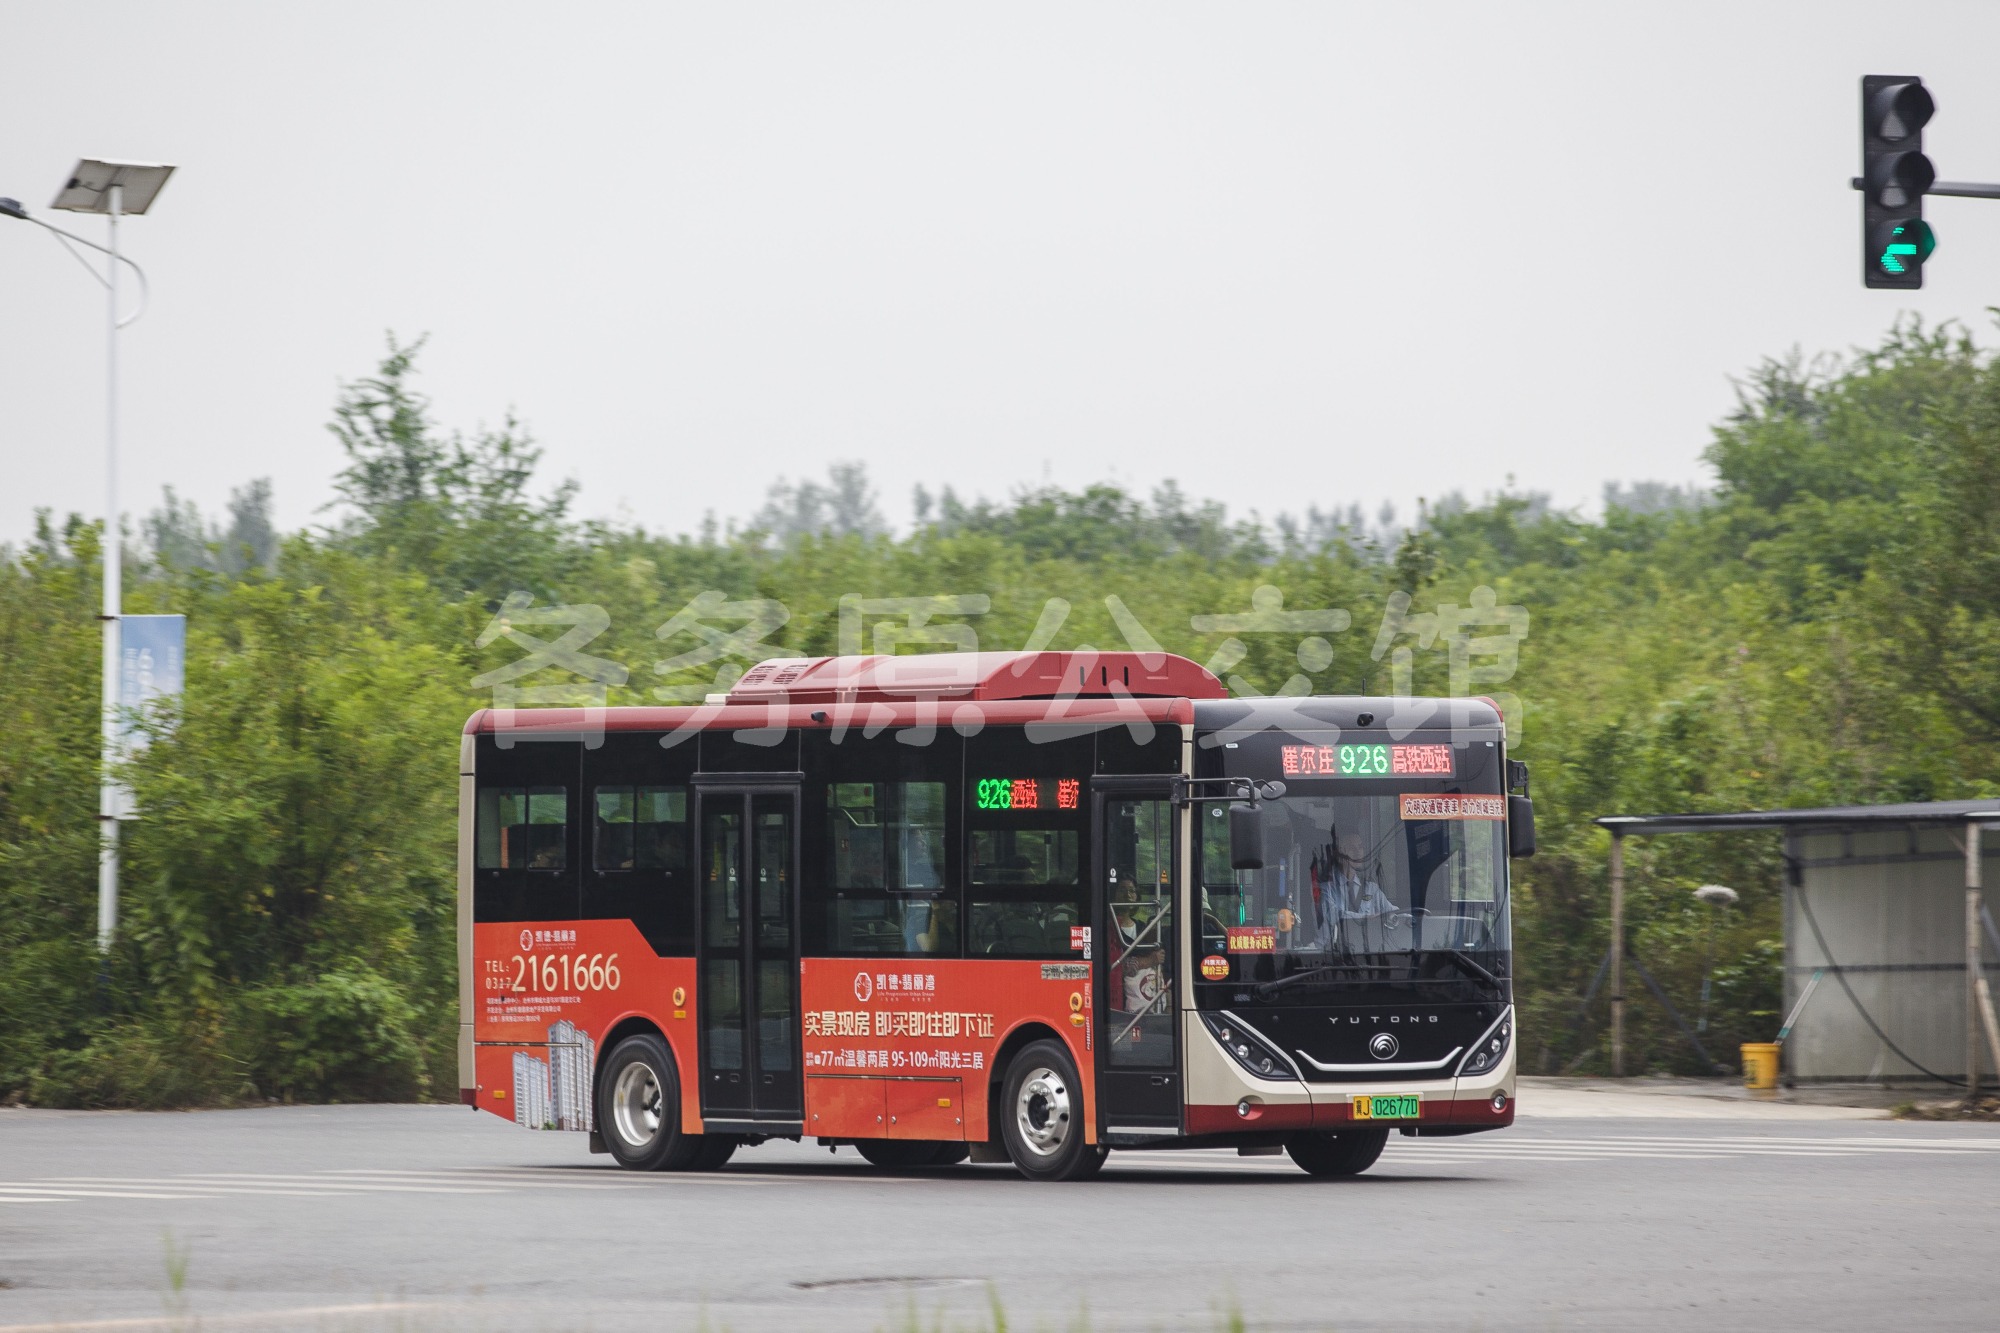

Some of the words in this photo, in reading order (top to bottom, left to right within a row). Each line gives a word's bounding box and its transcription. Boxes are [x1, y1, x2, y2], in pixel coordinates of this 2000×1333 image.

[1283, 746, 1335, 774] 崔尔庄
[1340, 745, 1388, 774] 926
[1391, 745, 1451, 774] 高铁西站
[978, 778, 1010, 808] 926
[1230, 935, 1274, 949] 优质服务示范车
[485, 960, 510, 972] TEL:
[511, 953, 621, 992] 2161666
[804, 1011, 870, 1037] 实景现房
[875, 1011, 995, 1038] 即买即住即下证
[1329, 1016, 1438, 1025] YUTONG
[1375, 1098, 1418, 1115] 02677D
